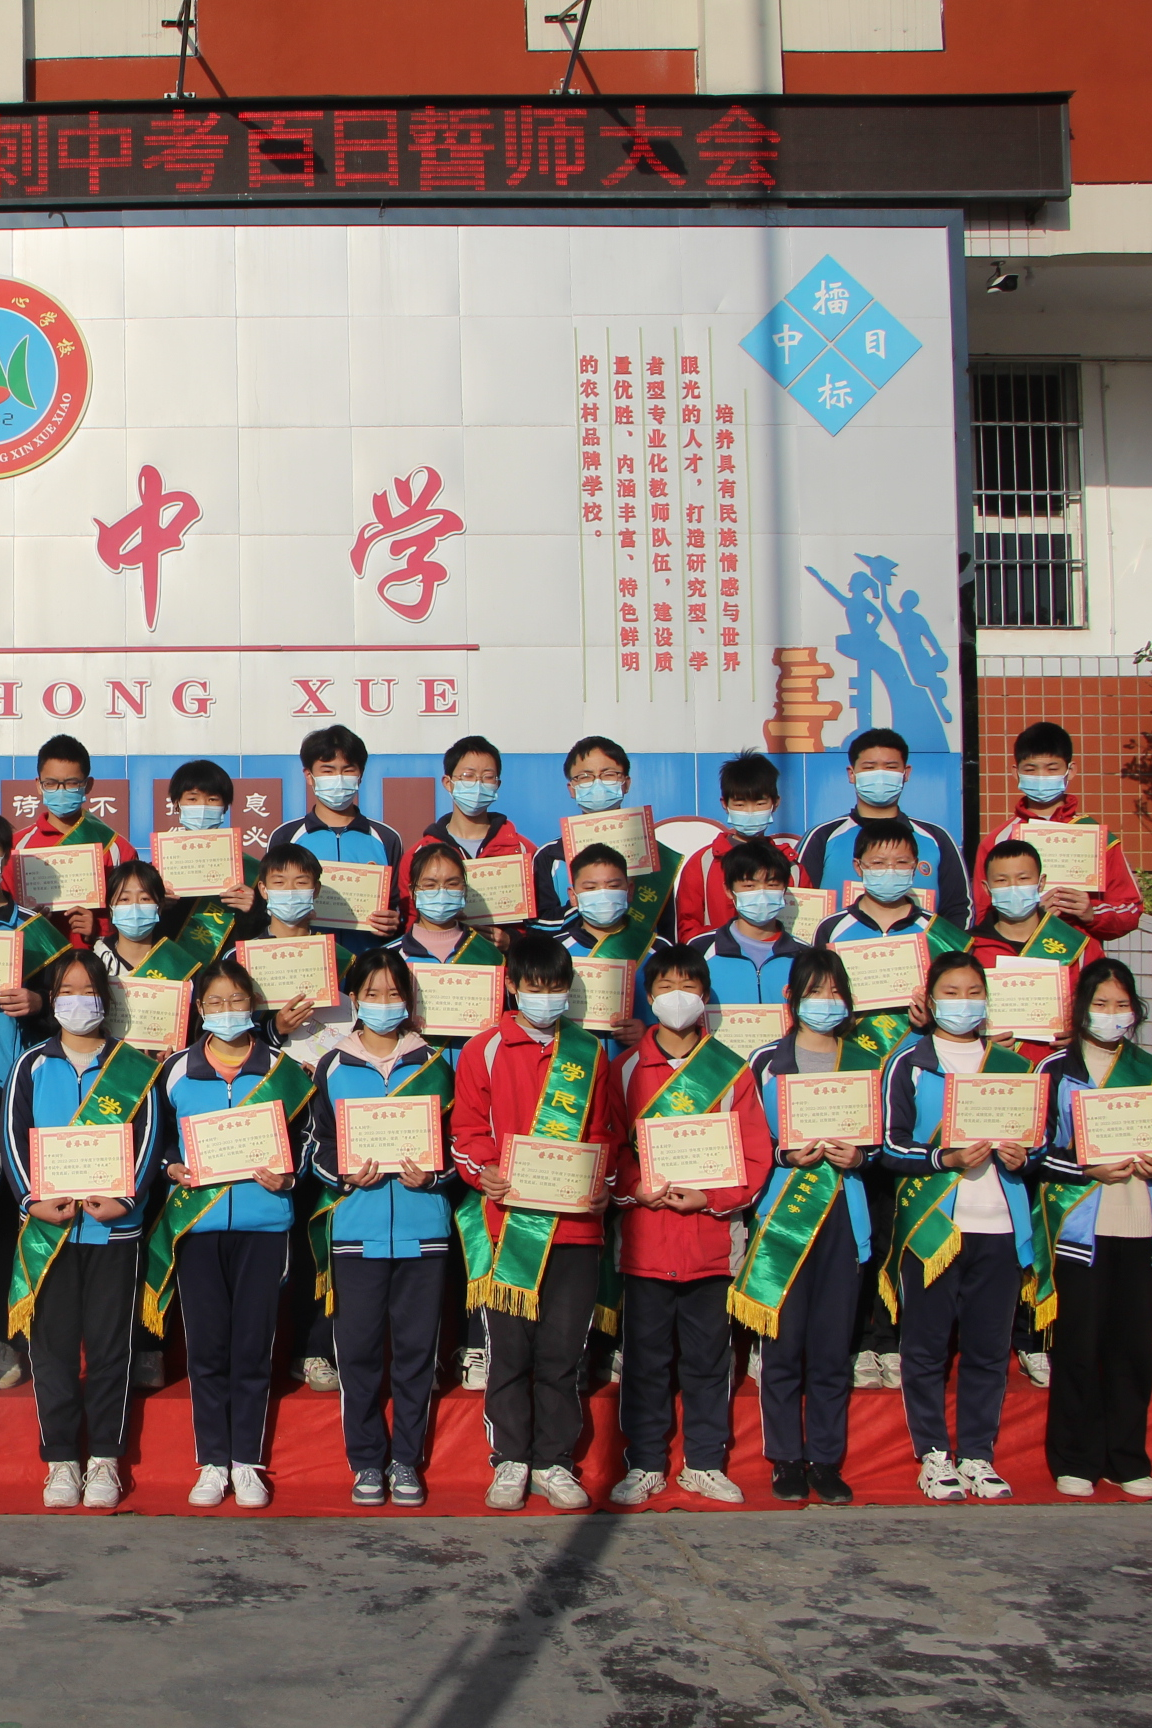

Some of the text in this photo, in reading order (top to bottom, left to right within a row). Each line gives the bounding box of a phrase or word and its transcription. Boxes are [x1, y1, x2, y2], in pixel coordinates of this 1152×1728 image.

[11, 440, 34, 460] XIN
[33, 424, 57, 446] XUE
[52, 392, 72, 425] XIAO
[580, 356, 602, 536] 的农村品牌学校。
[614, 357, 639, 670] 量优胜、内涵丰富、特色鲜明
[647, 357, 672, 671] 者型专业化教师队伍，建设质
[681, 357, 708, 671] 眼光的人才，打造研究型、学
[716, 405, 740, 671] 培养具有民族情感与世界
[293, 678, 458, 715] XUE
[12, 795, 41, 818] 诗
[89, 796, 118, 818] 不
[1042, 937, 1068, 955] 学
[541, 1061, 586, 1140] 学民奖
[787, 1172, 819, 1214] 擂鼓中学
